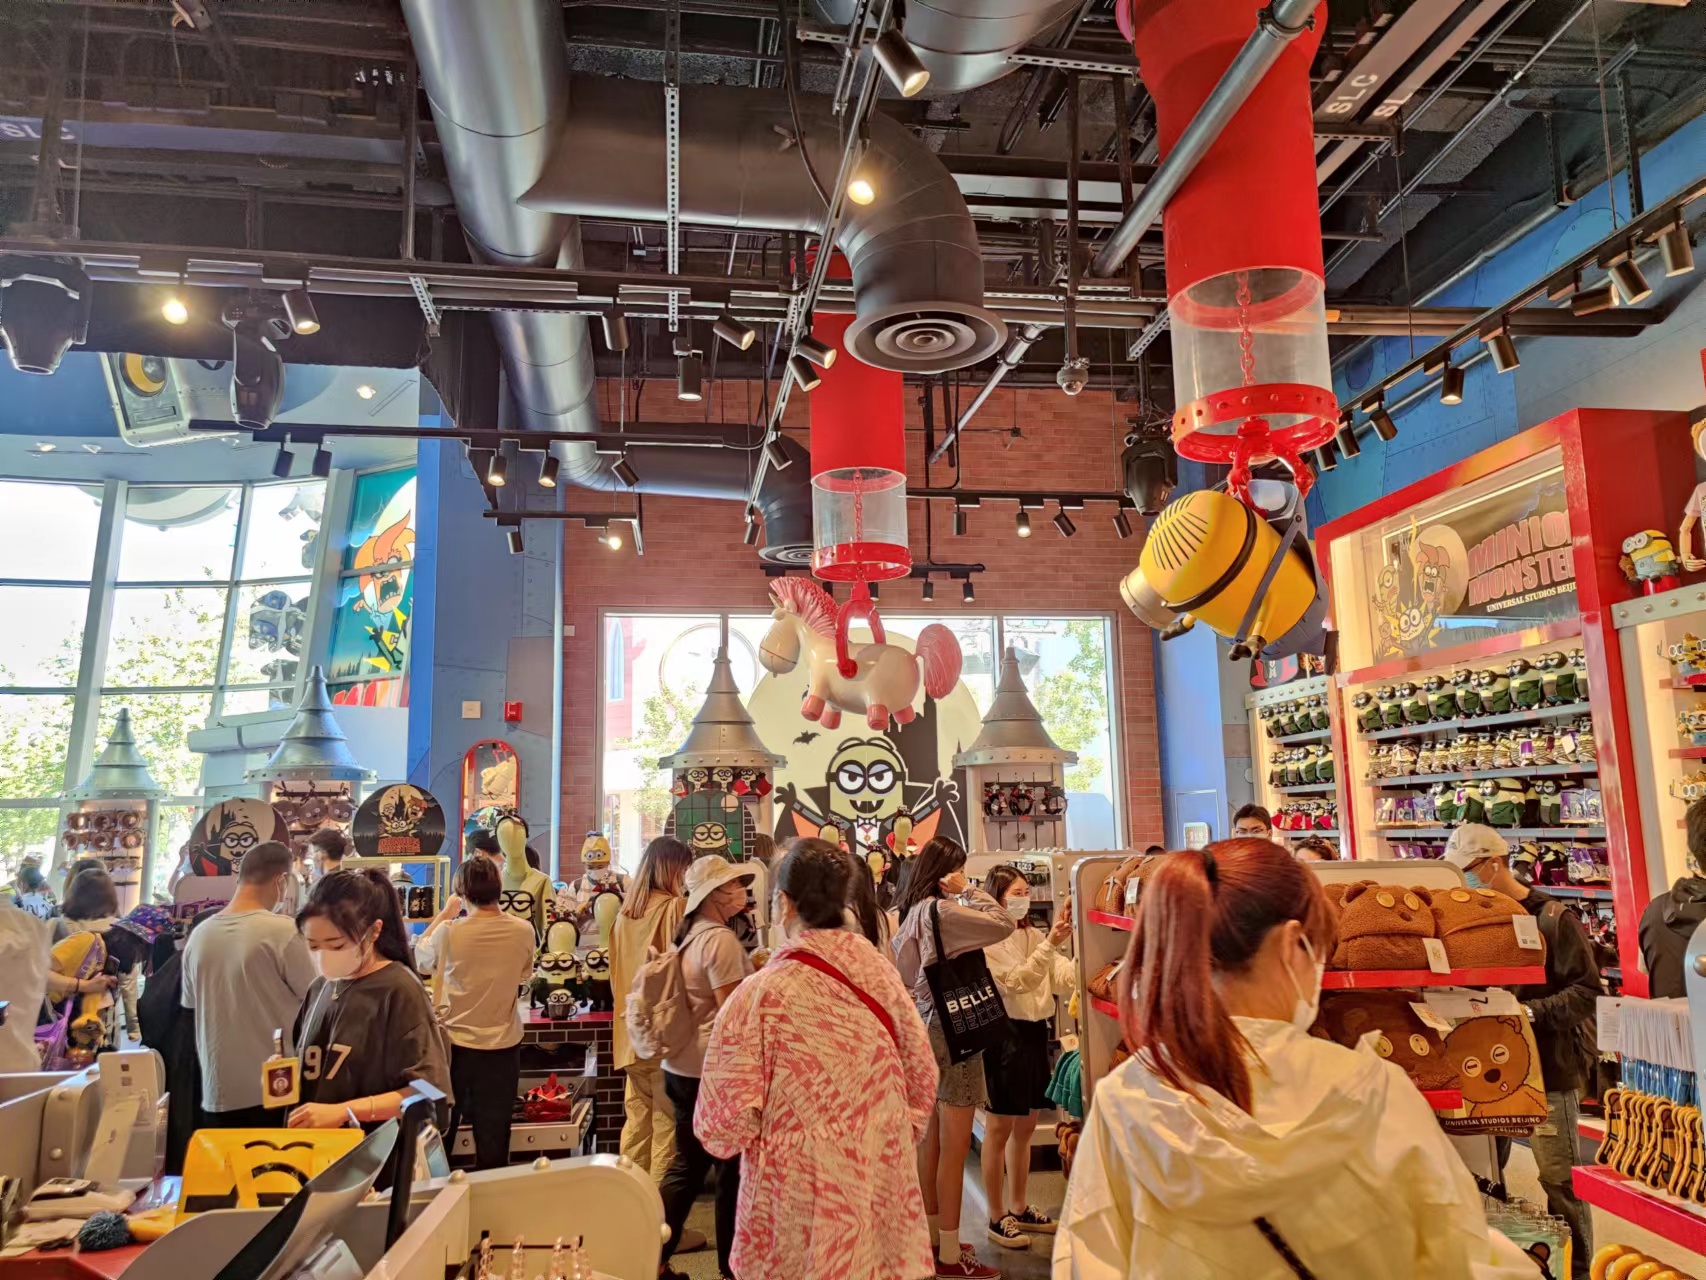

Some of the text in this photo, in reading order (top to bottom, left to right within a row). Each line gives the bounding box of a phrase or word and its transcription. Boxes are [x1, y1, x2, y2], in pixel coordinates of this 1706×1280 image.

[1325, 74, 1378, 114] SLC
[1486, 596, 1527, 613] UNIVERSAL
[1525, 587, 1557, 606] STUDIOS
[946, 985, 995, 1014] BELLE
[303, 1042, 353, 1081] 97
[1480, 1117, 1510, 1125] STUDIOS
